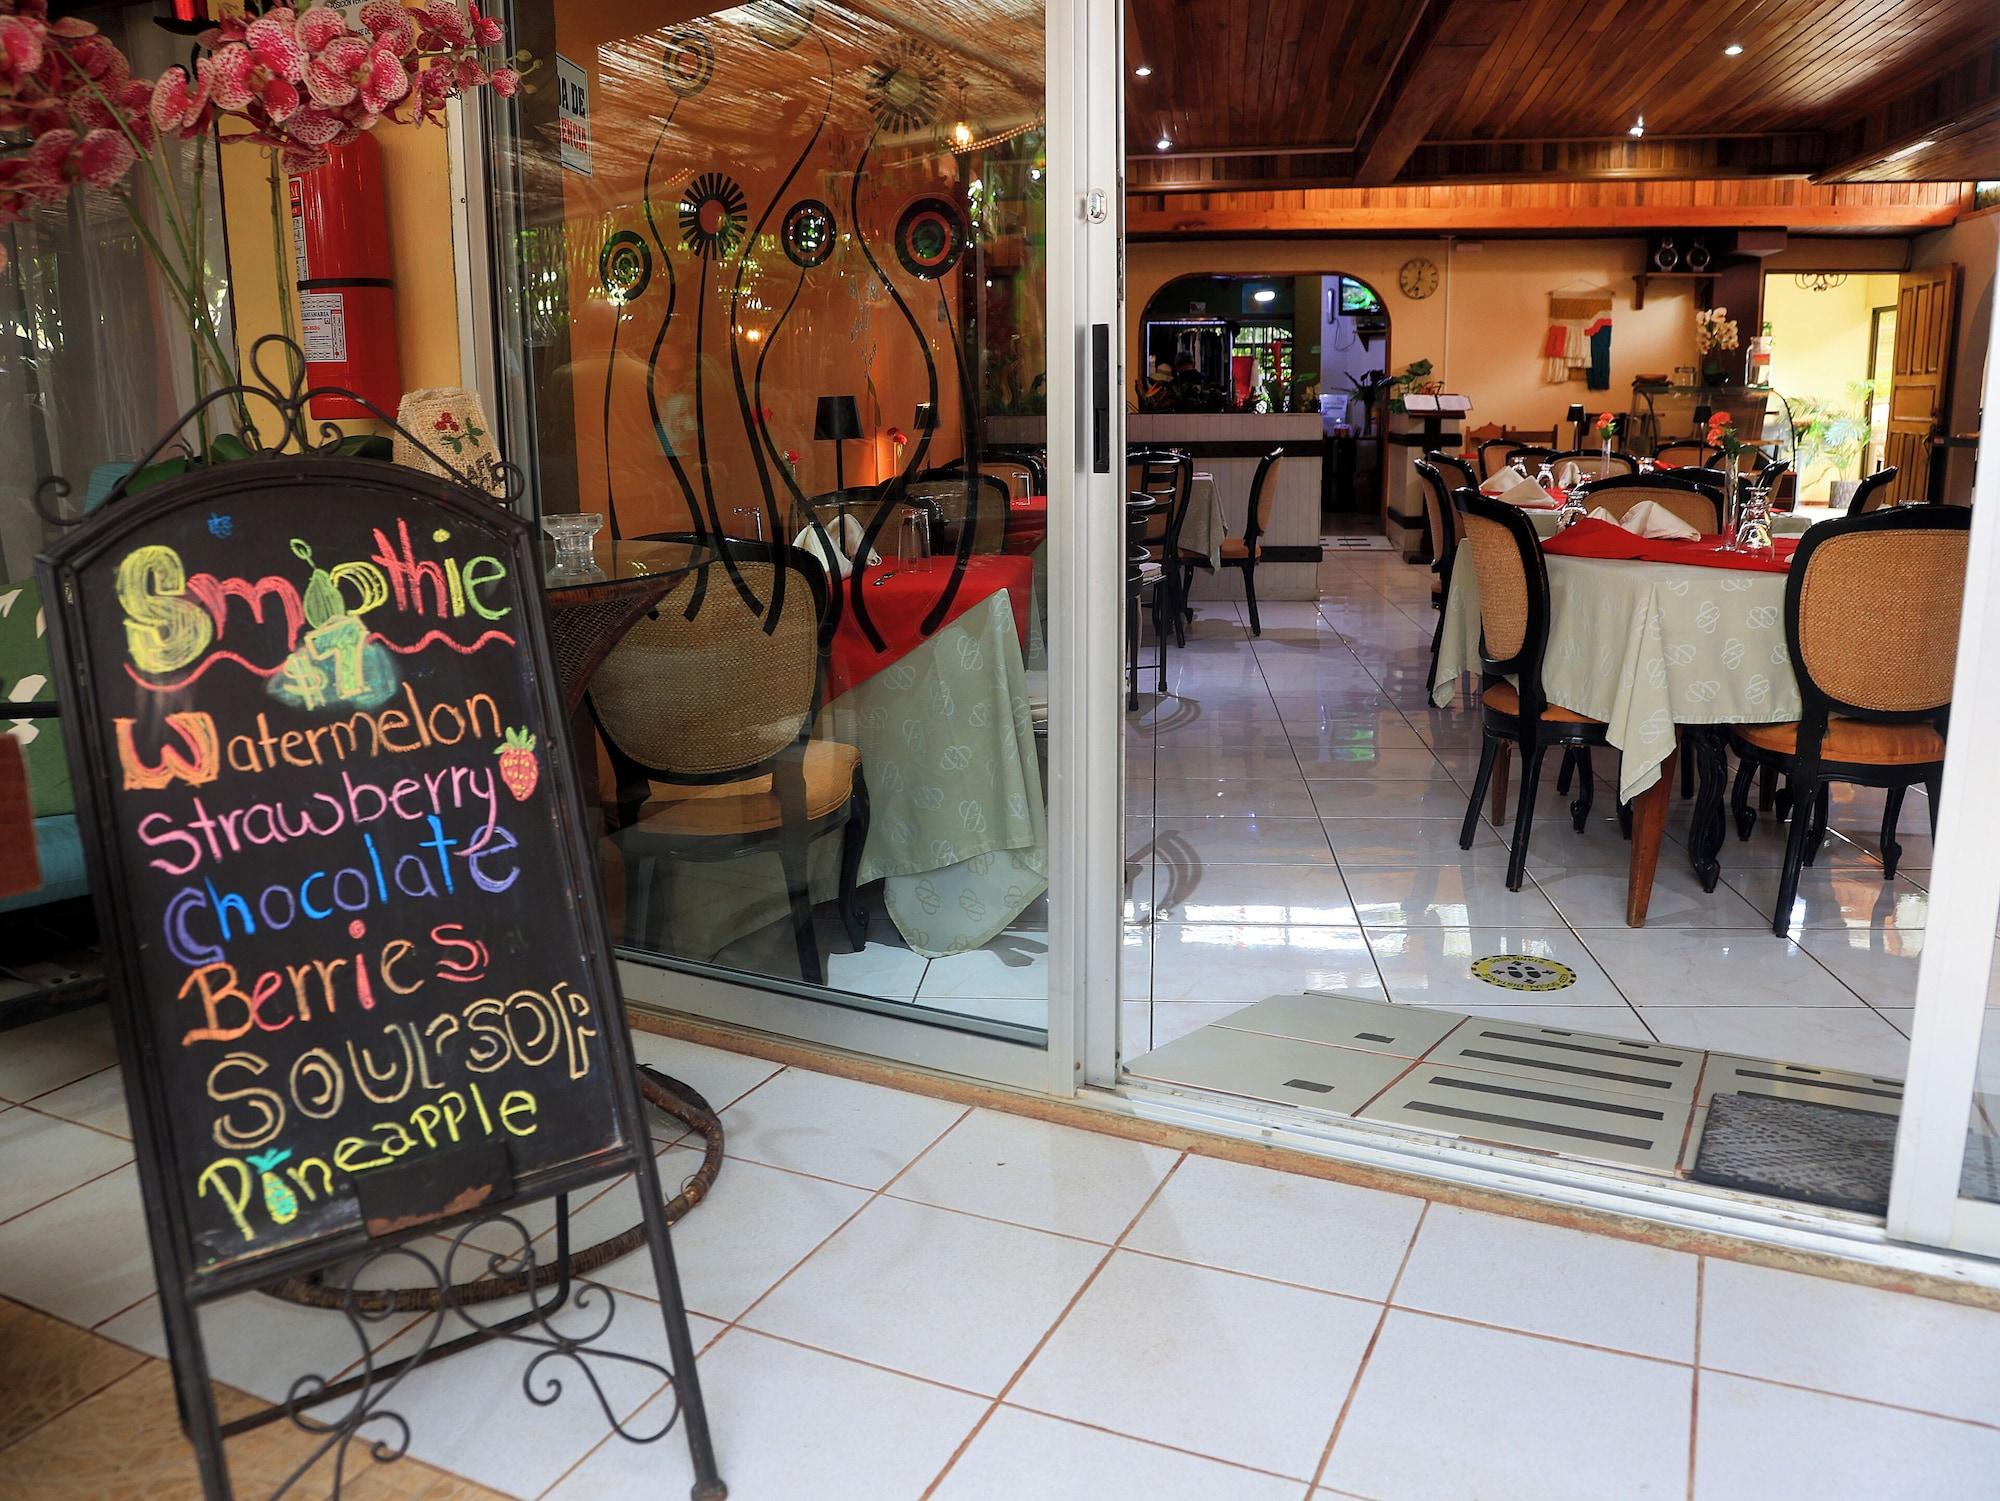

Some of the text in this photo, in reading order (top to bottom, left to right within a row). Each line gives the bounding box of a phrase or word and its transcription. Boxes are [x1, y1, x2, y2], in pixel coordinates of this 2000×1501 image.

[571, 81, 586, 119] DE
[281, 615, 370, 711] $7
[113, 682, 501, 790] Watermelon
[138, 762, 497, 875] Strawberry
[163, 813, 520, 967] Chocolate
